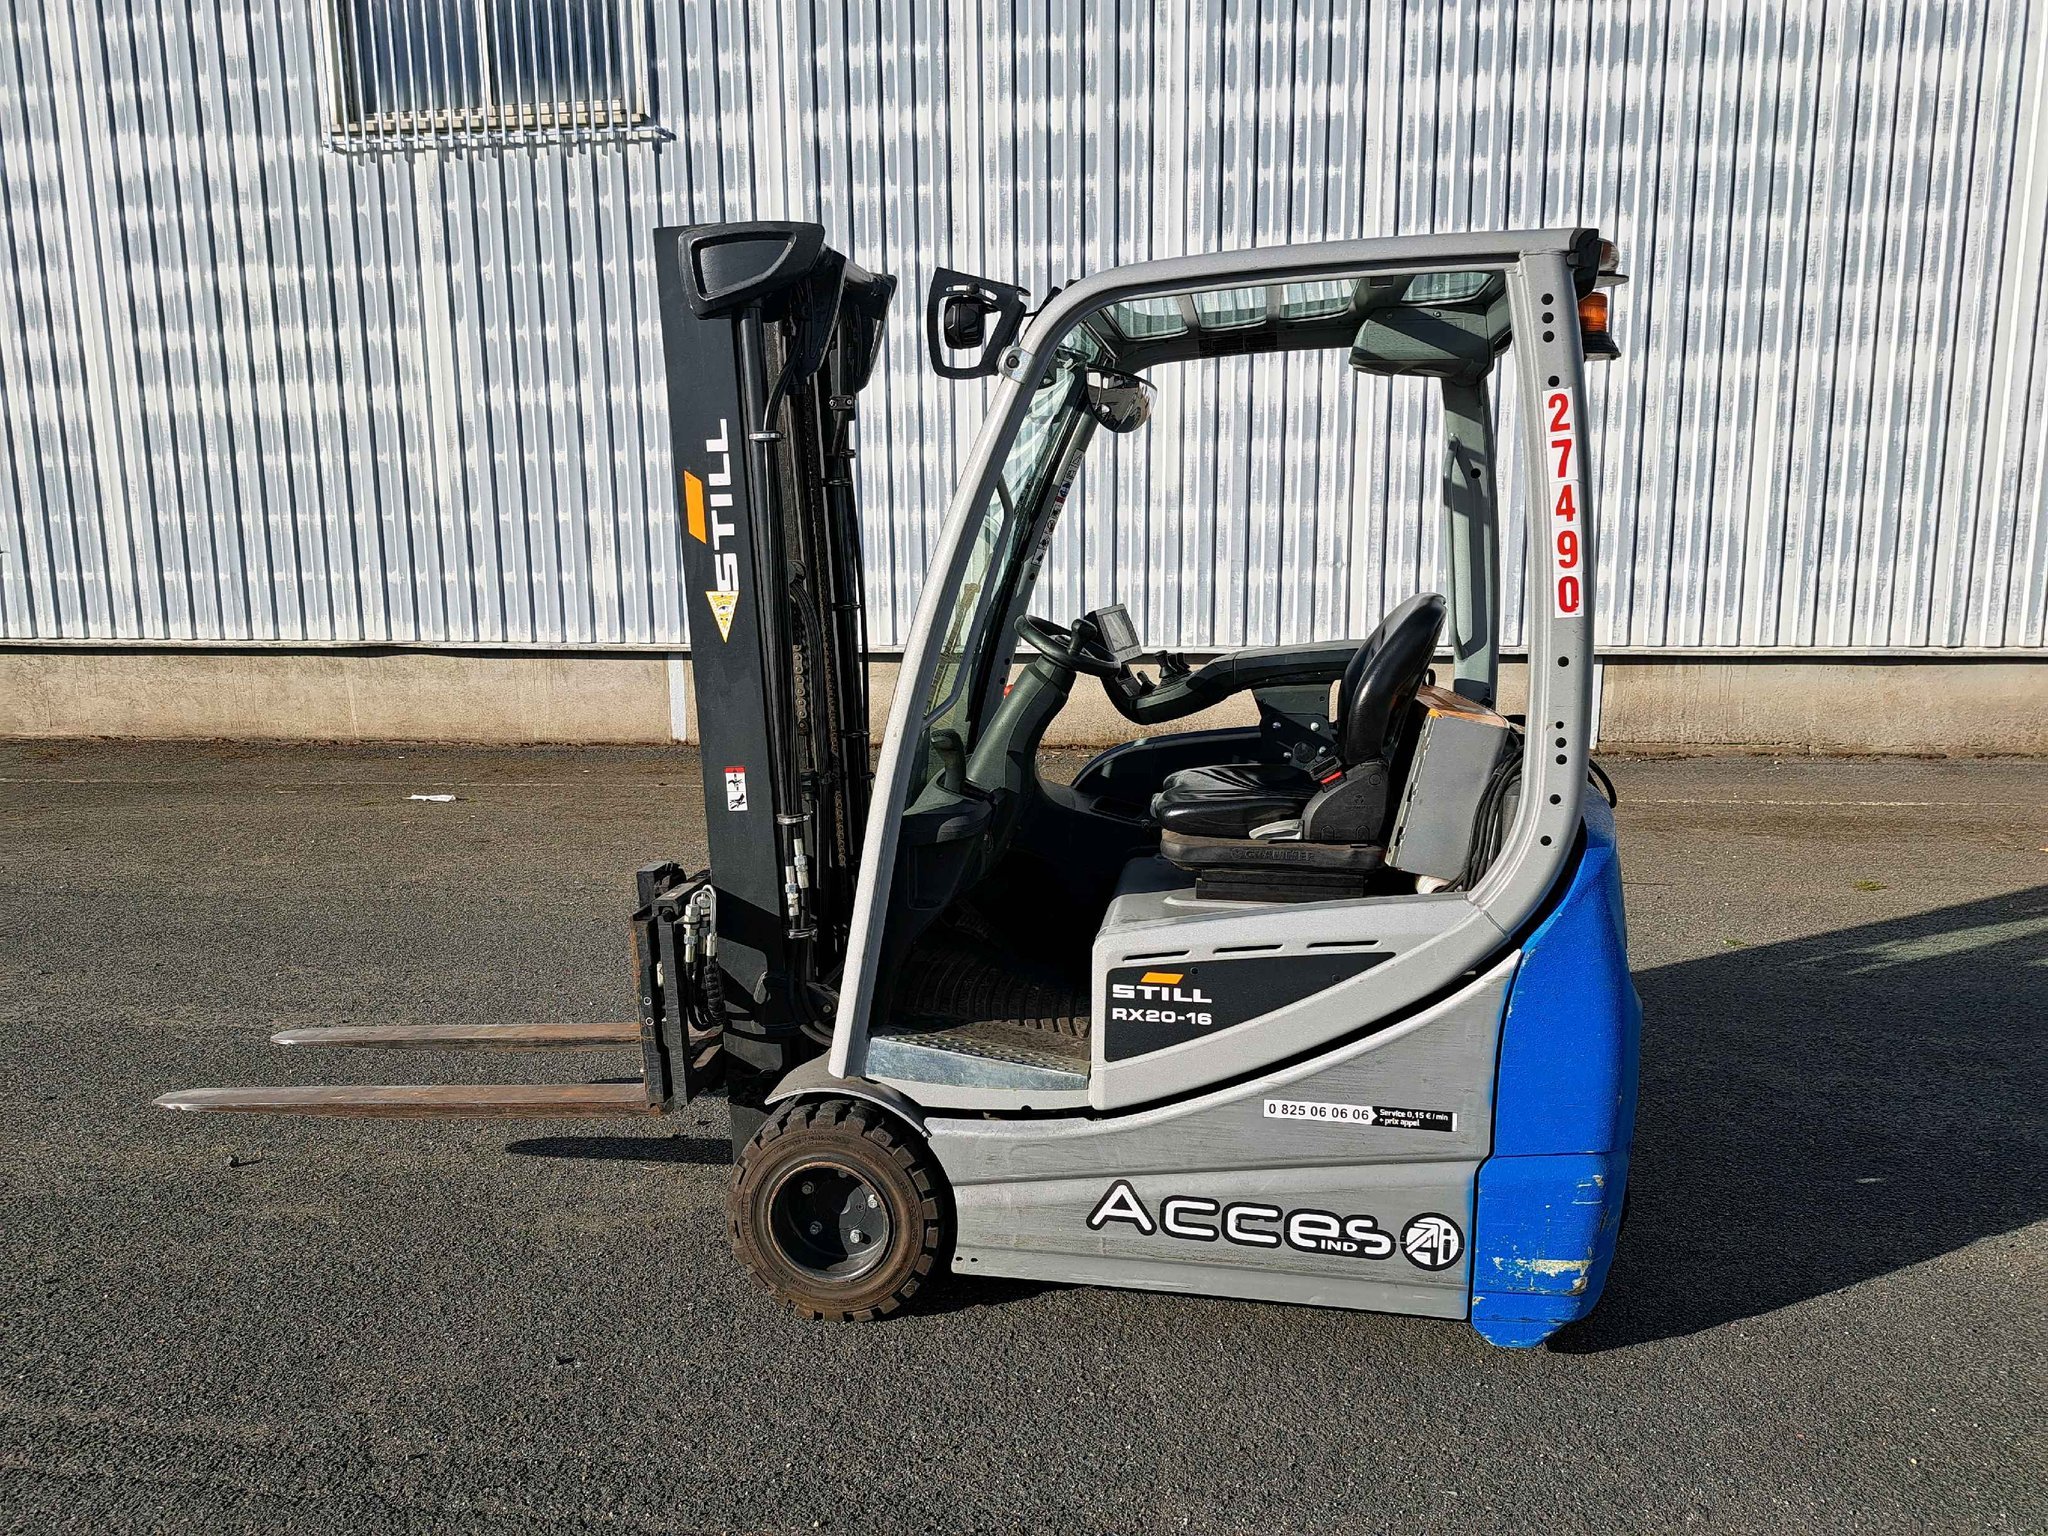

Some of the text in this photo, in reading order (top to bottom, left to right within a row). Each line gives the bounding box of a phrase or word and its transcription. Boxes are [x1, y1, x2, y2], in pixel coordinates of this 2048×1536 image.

[706, 418, 740, 592] STILL
[1548, 393, 1580, 613] 27490
[1112, 983, 1212, 1004] STILL
[1112, 1007, 1213, 1026] RX20-16
[1268, 1103, 1369, 1121] 0 825 06 06 06
[1379, 1108, 1406, 1119] Service
[1407, 1110, 1425, 1120] 0,15
[1385, 1117, 1399, 1127] prix
[1400, 1118, 1420, 1127] appel
[1088, 1181, 1394, 1258] Acces
[1320, 1238, 1358, 1253] IND
